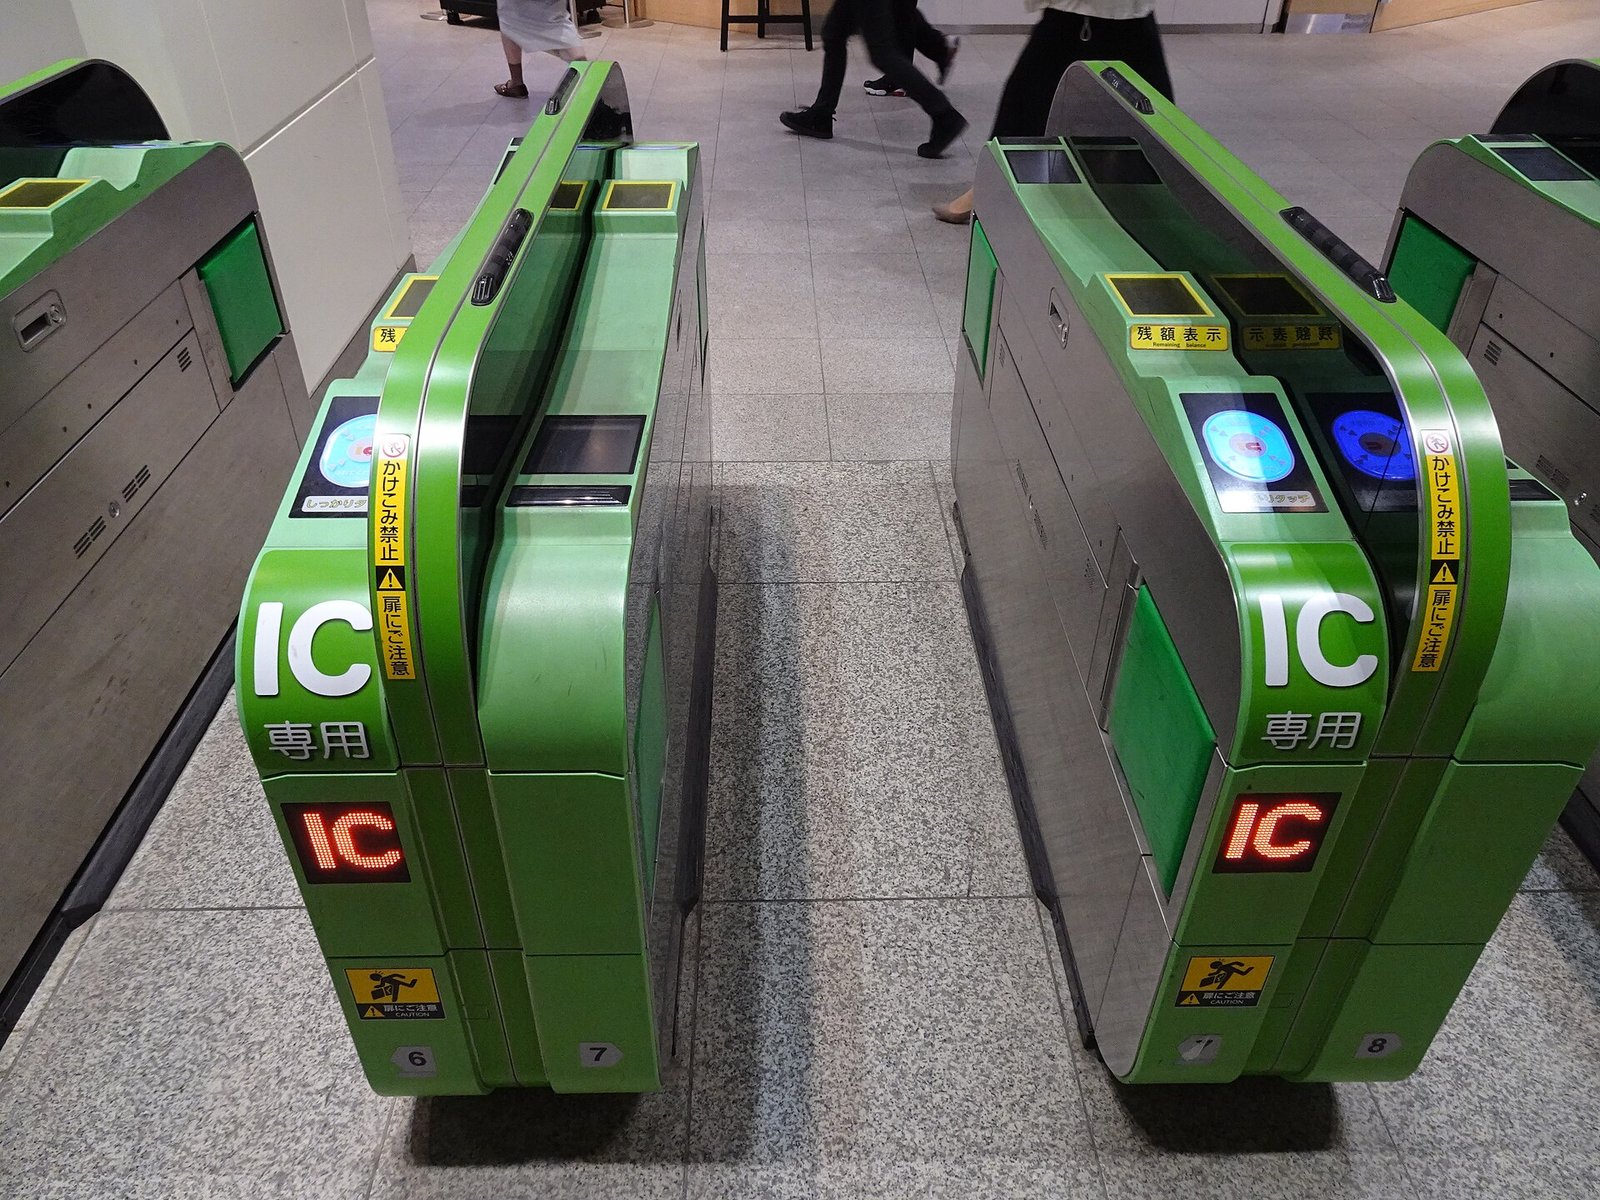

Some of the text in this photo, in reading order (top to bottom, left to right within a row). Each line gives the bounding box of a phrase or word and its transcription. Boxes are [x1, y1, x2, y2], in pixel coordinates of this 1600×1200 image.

[1137, 326, 1222, 342] 残額表示
[380, 460, 401, 561] かけこみ禁止
[1432, 456, 1455, 555] かけこみ禁止
[254, 600, 374, 696] IC
[382, 595, 410, 676] 扉にご注意
[1259, 592, 1379, 687] IC
[1417, 590, 1451, 668] 扉にご注意
[263, 720, 371, 760] 専用
[1260, 710, 1362, 750] 専用
[303, 812, 401, 869] IC
[1225, 803, 1323, 858] IC
[408, 1051, 427, 1067] 6
[589, 1047, 608, 1062] 7
[1367, 1038, 1387, 1053] 8
